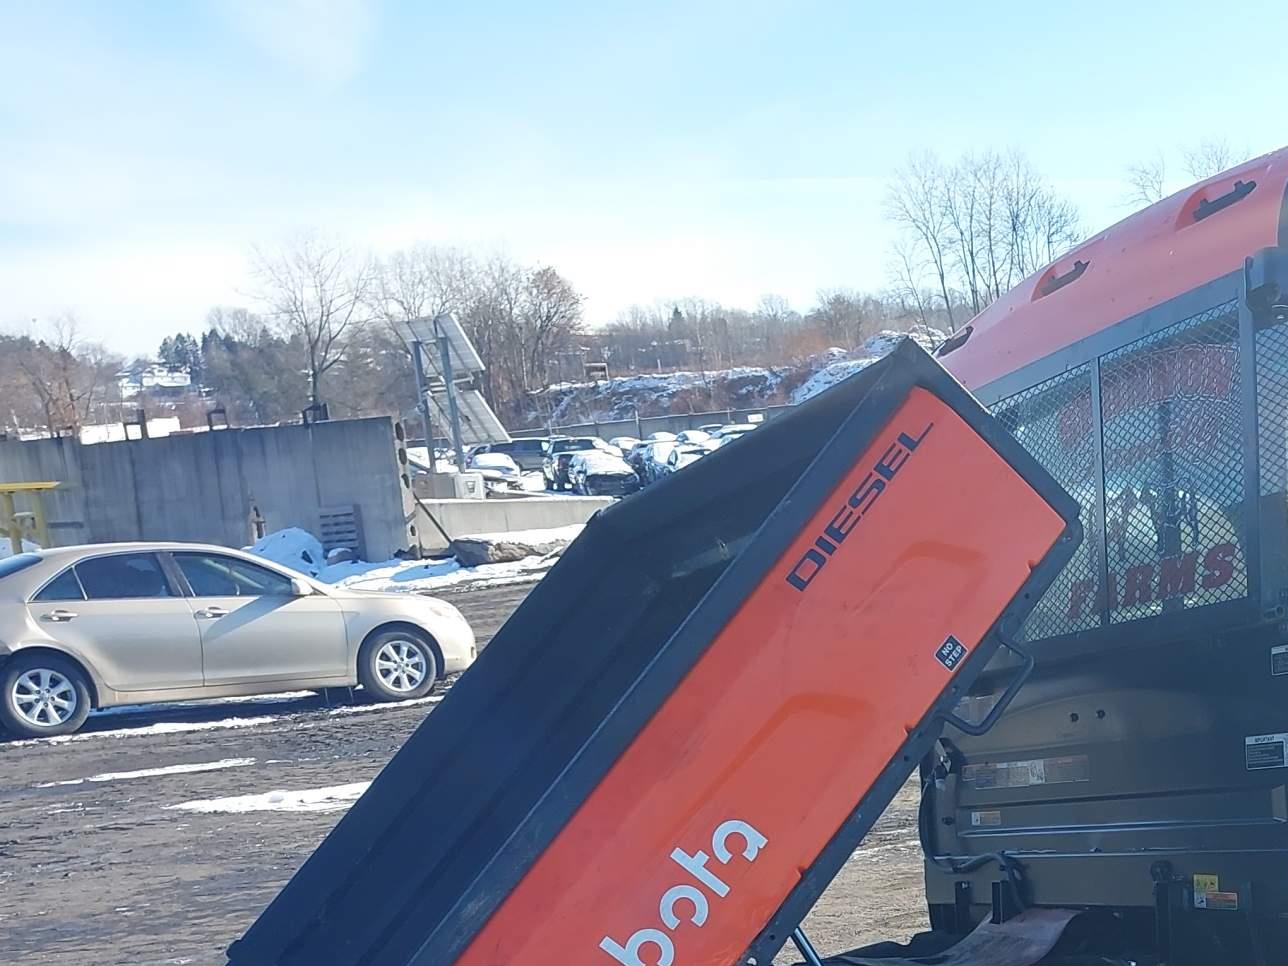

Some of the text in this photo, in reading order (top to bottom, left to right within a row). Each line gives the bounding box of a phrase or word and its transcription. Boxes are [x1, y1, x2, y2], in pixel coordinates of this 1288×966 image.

[786, 422, 934, 591] DIESEL
[1068, 543, 1237, 621] FARMS
[941, 642, 954, 656] NO
[945, 645, 962, 667] STEP
